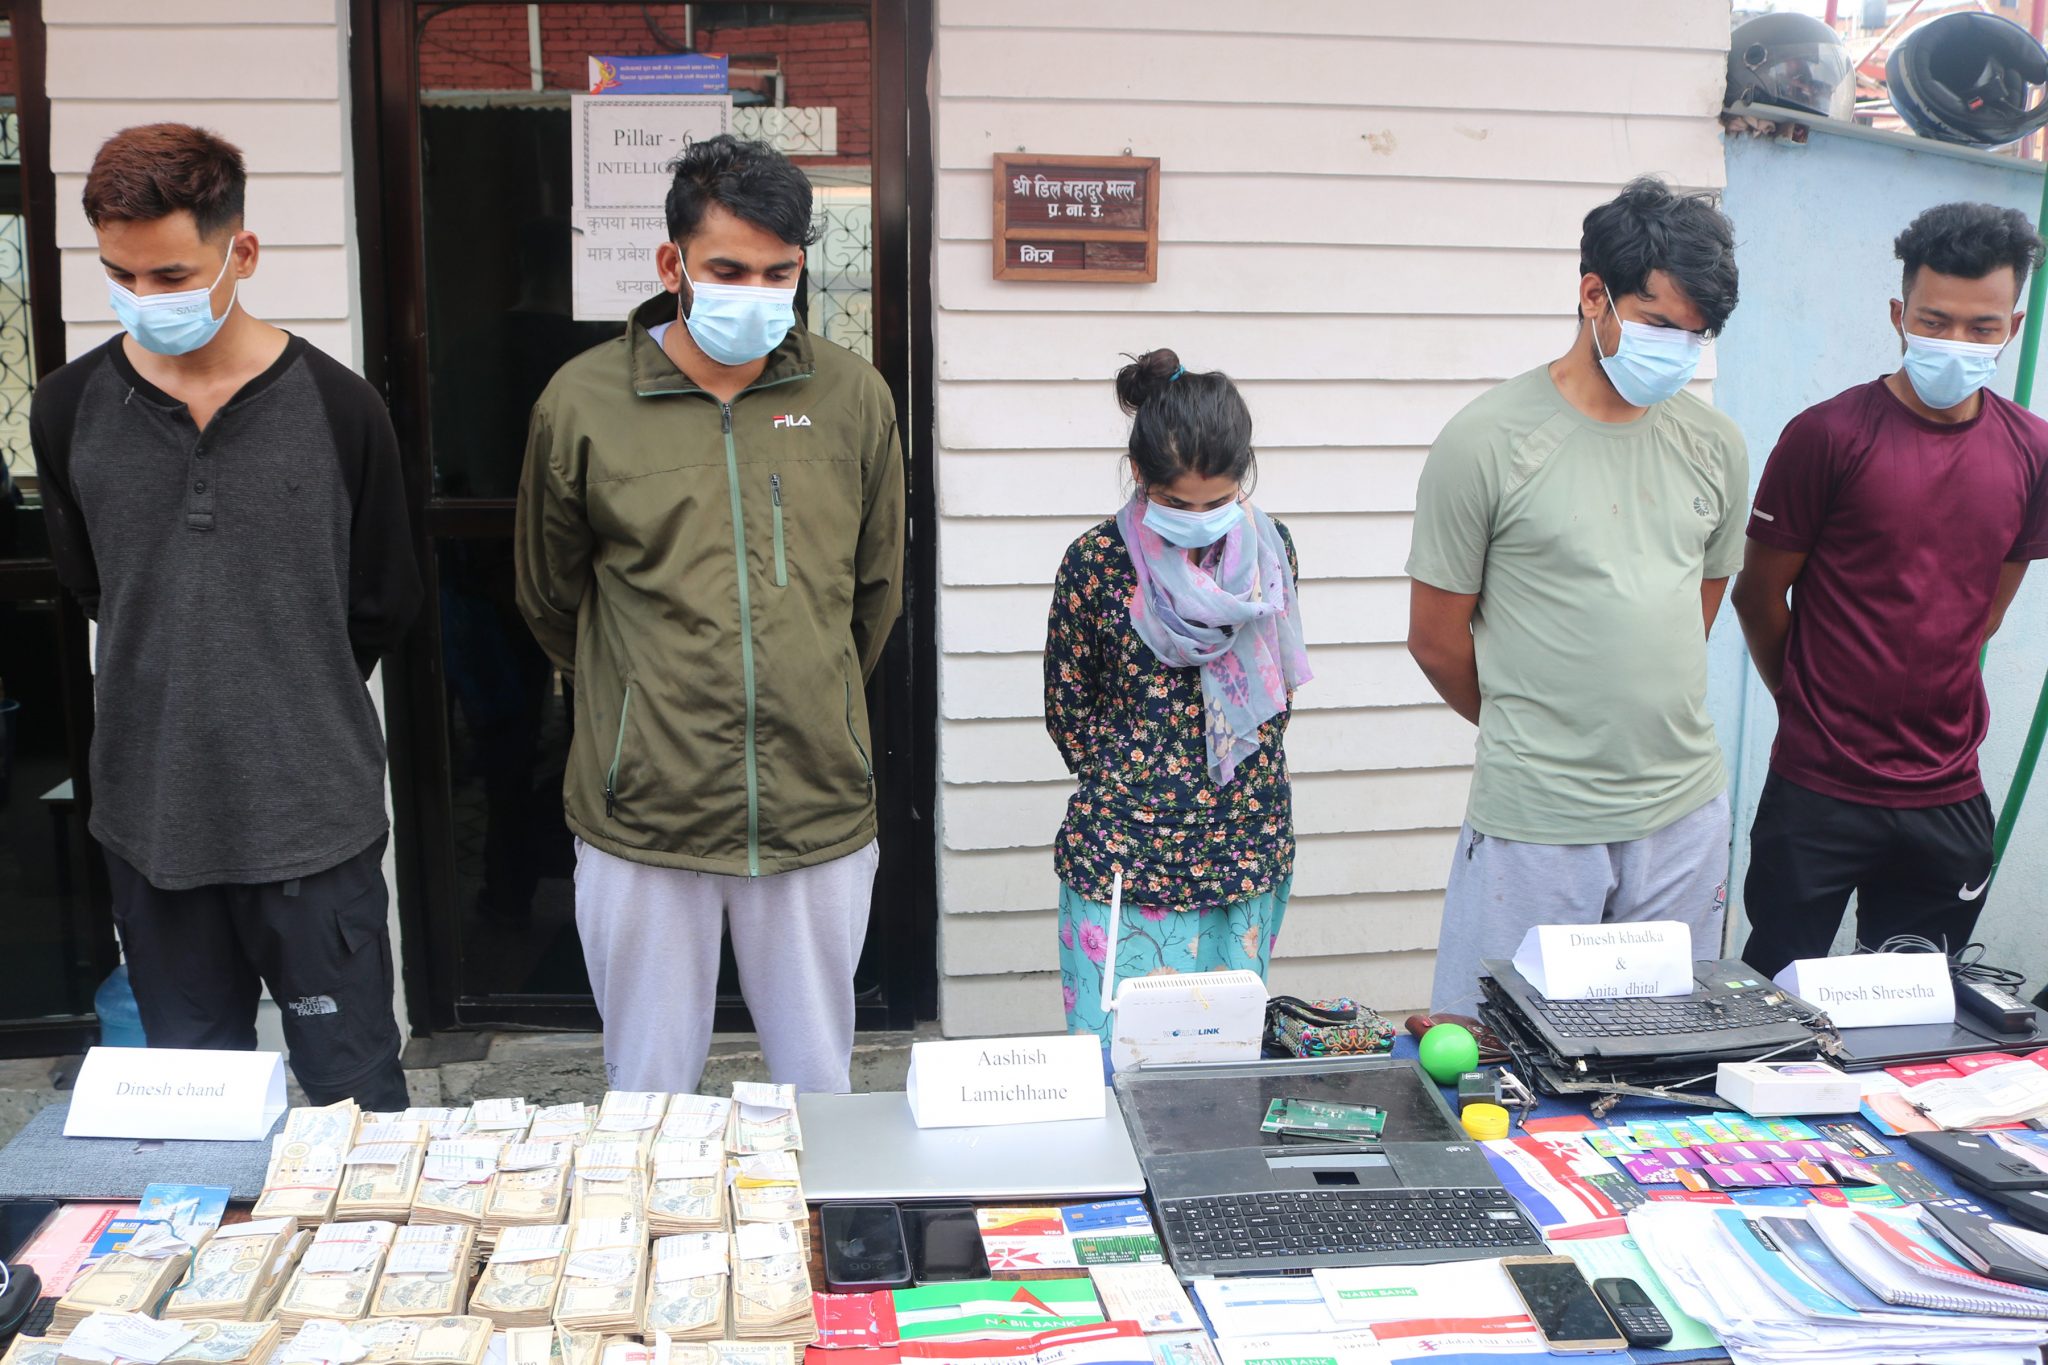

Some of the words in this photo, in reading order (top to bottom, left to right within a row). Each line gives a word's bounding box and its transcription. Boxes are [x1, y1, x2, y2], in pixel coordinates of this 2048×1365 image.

[614, 129, 663, 146] Pillar
[682, 128, 693, 146] 6
[1013, 175, 1032, 198] श्री
[1063, 181, 1104, 203] बहादुर
[1106, 180, 1136, 201] मल्ल
[1066, 203, 1086, 217] ना.
[1091, 204, 1104, 217] उ.
[587, 217, 625, 235] कृपया
[586, 248, 613, 262] मात्र
[616, 242, 651, 262] प्रबेश
[1020, 245, 1054, 264] भित्र
[772, 414, 812, 429] FILA
[1570, 932, 1616, 947] Dinesh
[1619, 931, 1664, 944] khadka
[1615, 957, 1628, 971] &
[1585, 984, 1619, 998] Anita
[1625, 980, 1660, 995] dhital
[1819, 986, 1868, 1005] Dipesh
[1872, 983, 1935, 1001] Shrestha
[288, 1002, 320, 1010] NORTH
[298, 996, 318, 1004] THE
[297, 1008, 323, 1016] FACE
[978, 1048, 1047, 1067] Aashish
[116, 1081, 172, 1096] Dinesh
[177, 1082, 226, 1097] chand
[961, 1084, 1068, 1102] Lamichhane
[849, 1260, 886, 1271] 2:06
[1340, 1290, 1377, 1299] NABIL
[1380, 1288, 1414, 1296] BANK
[985, 1316, 1031, 1328] NABIL
[1033, 1320, 1076, 1328] BANK
[1505, 1337, 1534, 1345] Bank
